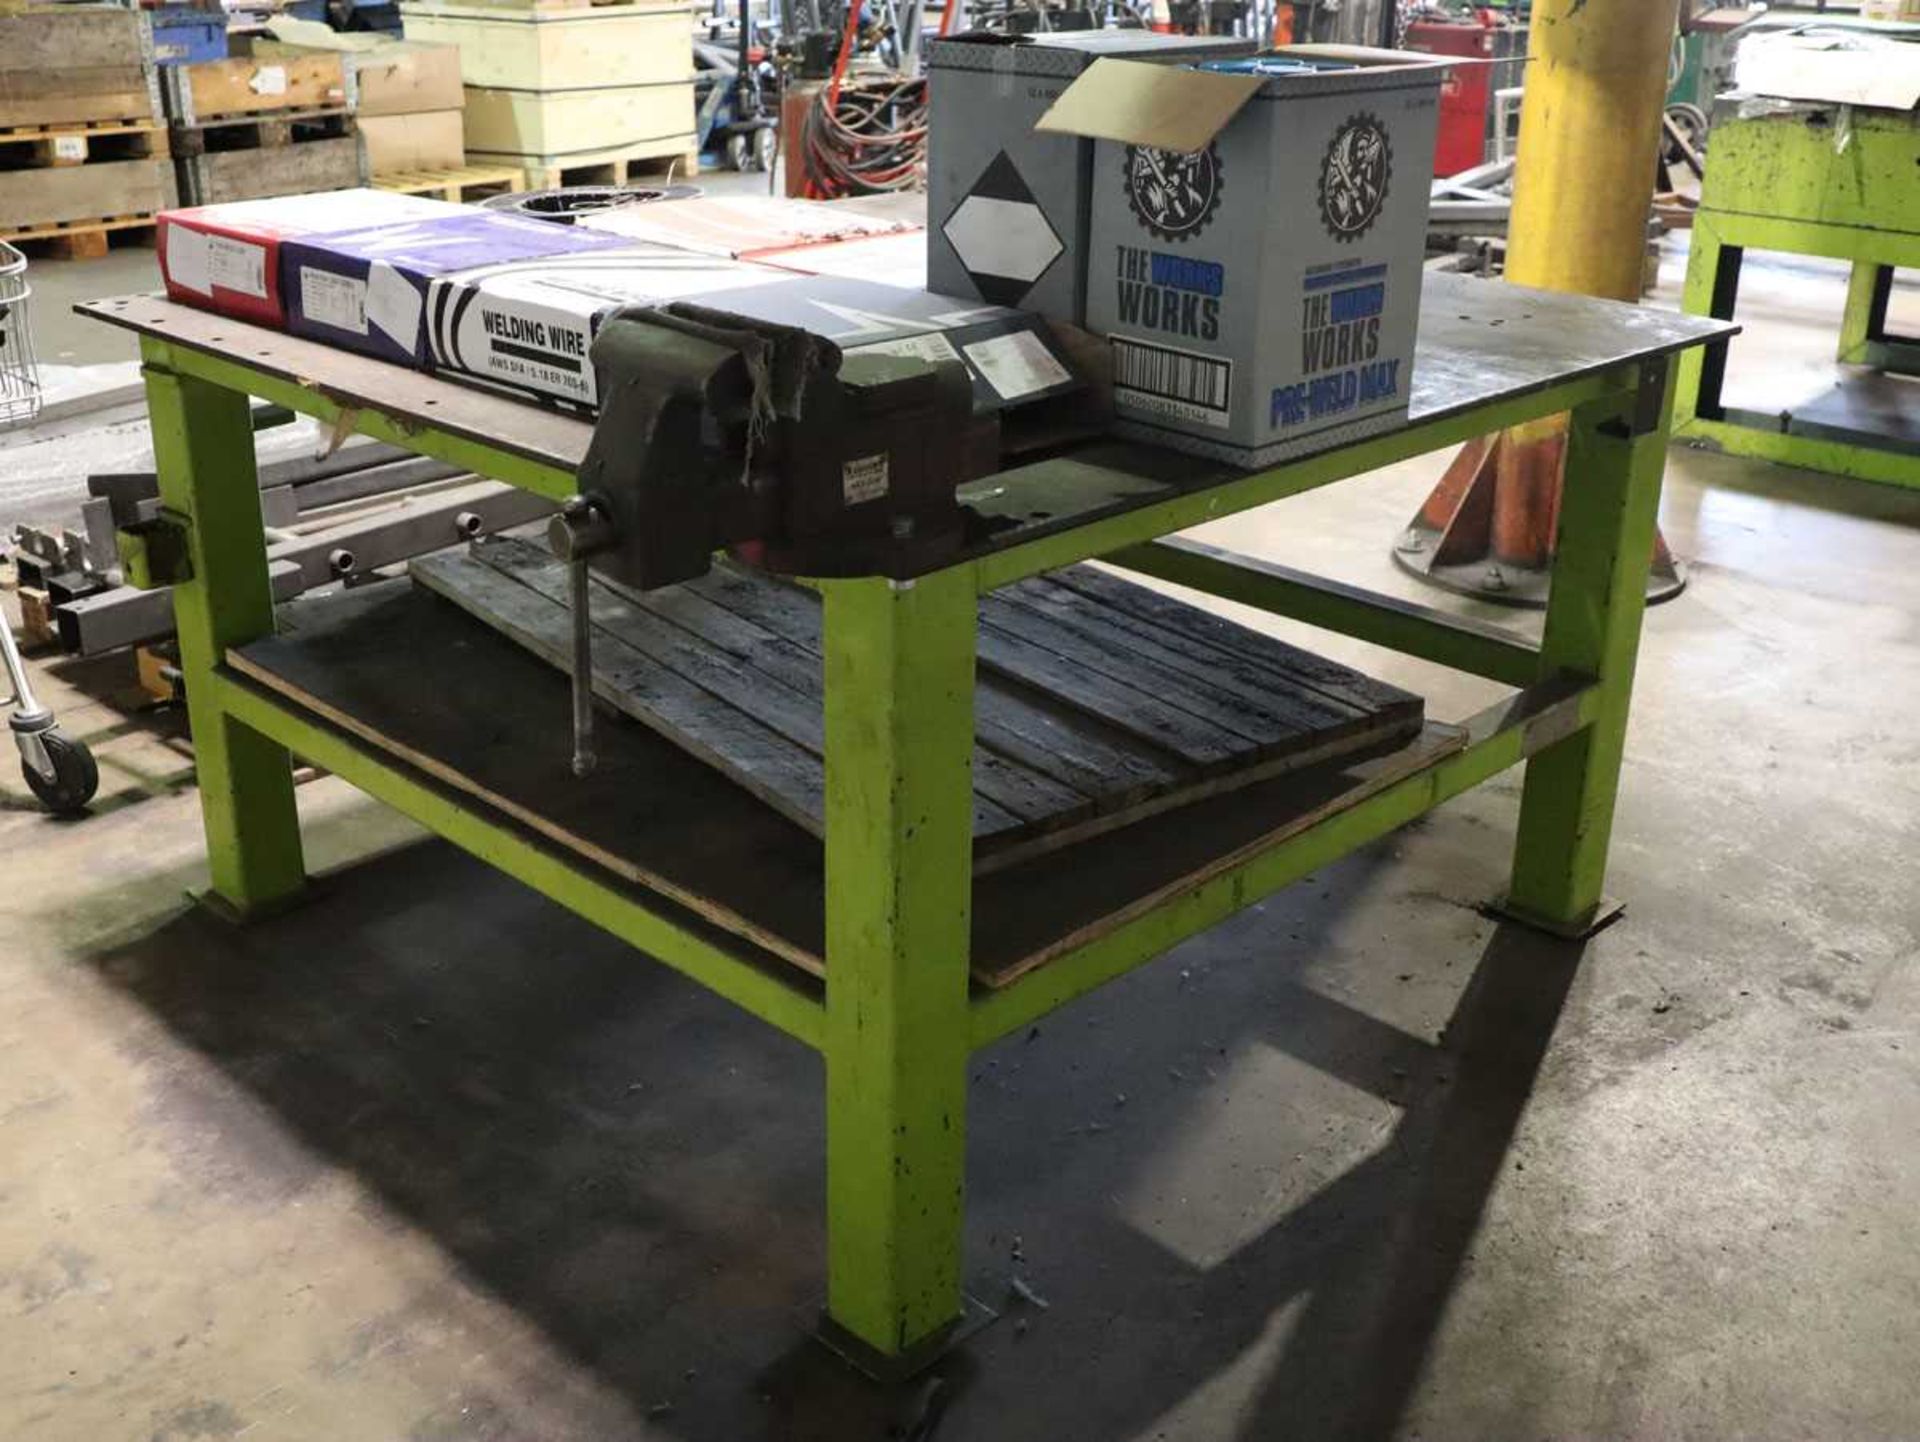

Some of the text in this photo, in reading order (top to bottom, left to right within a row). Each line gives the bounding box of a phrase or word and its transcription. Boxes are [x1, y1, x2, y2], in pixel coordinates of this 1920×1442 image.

[1117, 245, 1148, 282] THE
[483, 309, 585, 356] WELDING WIRE
[1117, 280, 1219, 340] WORKS
[1303, 294, 1329, 329] THE
[1302, 318, 1380, 375] WORKS
